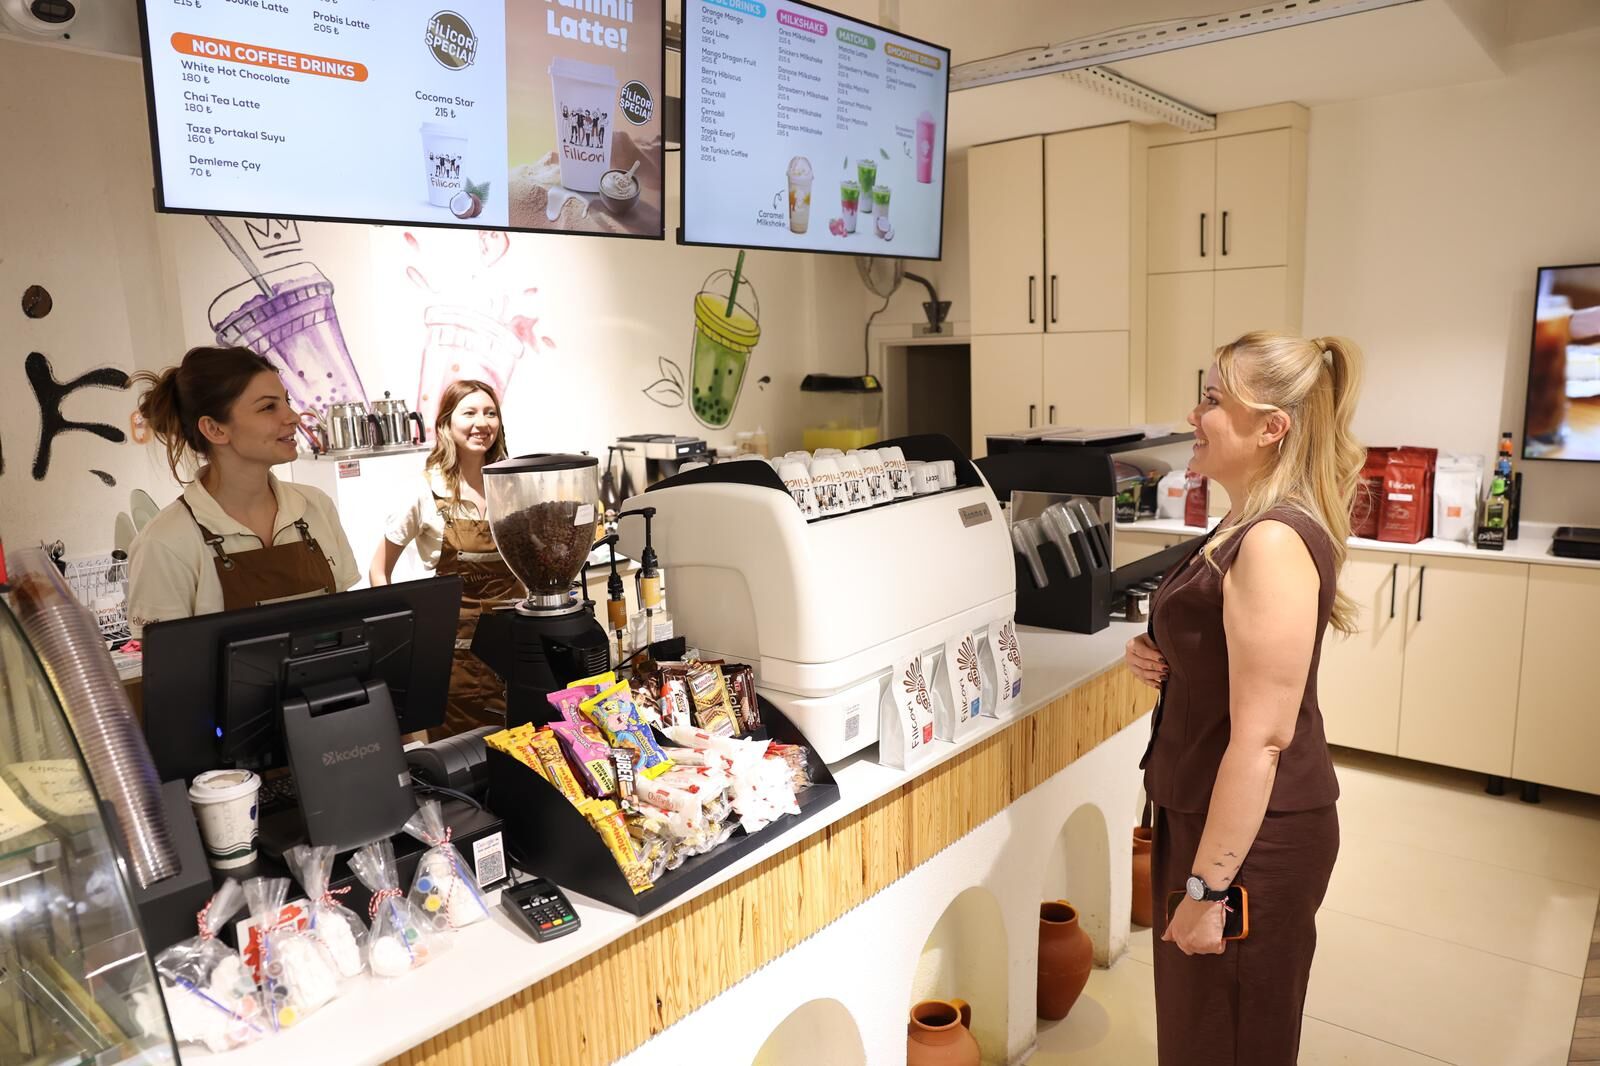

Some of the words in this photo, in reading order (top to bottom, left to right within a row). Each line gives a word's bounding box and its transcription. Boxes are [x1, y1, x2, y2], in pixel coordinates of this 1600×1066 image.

[262, 1, 289, 13] Latte
[313, 11, 343, 25] Probis
[346, 17, 370, 30] Latte
[702, 6, 722, 19] Orange
[725, 13, 743, 25] Mango
[781, 13, 823, 34] MILKSHAKE
[314, 23, 332, 34] 205
[547, 9, 629, 52] Latte!
[702, 27, 714, 36] Cool
[716, 31, 729, 40] Lime
[839, 32, 867, 47] MATCHA
[425, 31, 475, 65] SPECIAL
[192, 39, 230, 58] NON
[234, 46, 297, 69] COFFEE
[300, 58, 355, 78] DRINKS
[702, 48, 721, 59] Mango
[723, 53, 741, 64] Dragon
[744, 58, 756, 66] Fruit
[181, 60, 215, 74] White
[218, 66, 237, 77] Hot
[240, 69, 290, 85] Chocolate
[182, 72, 201, 83] 180
[702, 68, 717, 77] Berry
[719, 72, 741, 81] Hibiscus
[184, 91, 209, 102] Chai
[211, 95, 230, 105] Tea
[233, 98, 261, 109] Latte
[185, 103, 204, 113] 180
[455, 97, 475, 108] Star
[435, 107, 448, 118] 215
[619, 98, 652, 121] SPECIAL
[186, 123, 211, 134] Taze
[214, 126, 259, 140] Portakal
[261, 131, 286, 143] Suyu
[187, 134, 206, 144] 160
[701, 127, 717, 136] Tropik
[563, 145, 605, 163] Filicori
[710, 146, 729, 155] Turkish
[731, 150, 748, 158] Coffee
[189, 155, 239, 168] Demleme
[241, 160, 261, 172] Çay
[190, 168, 203, 177] 70
[430, 176, 461, 189] Filicori
[758, 209, 785, 220] Caramel
[756, 218, 786, 229] Milkshake
[960, 678, 969, 723] Filicori
[908, 701, 920, 749] Filicori
[606, 816, 627, 854] GRANOLA
